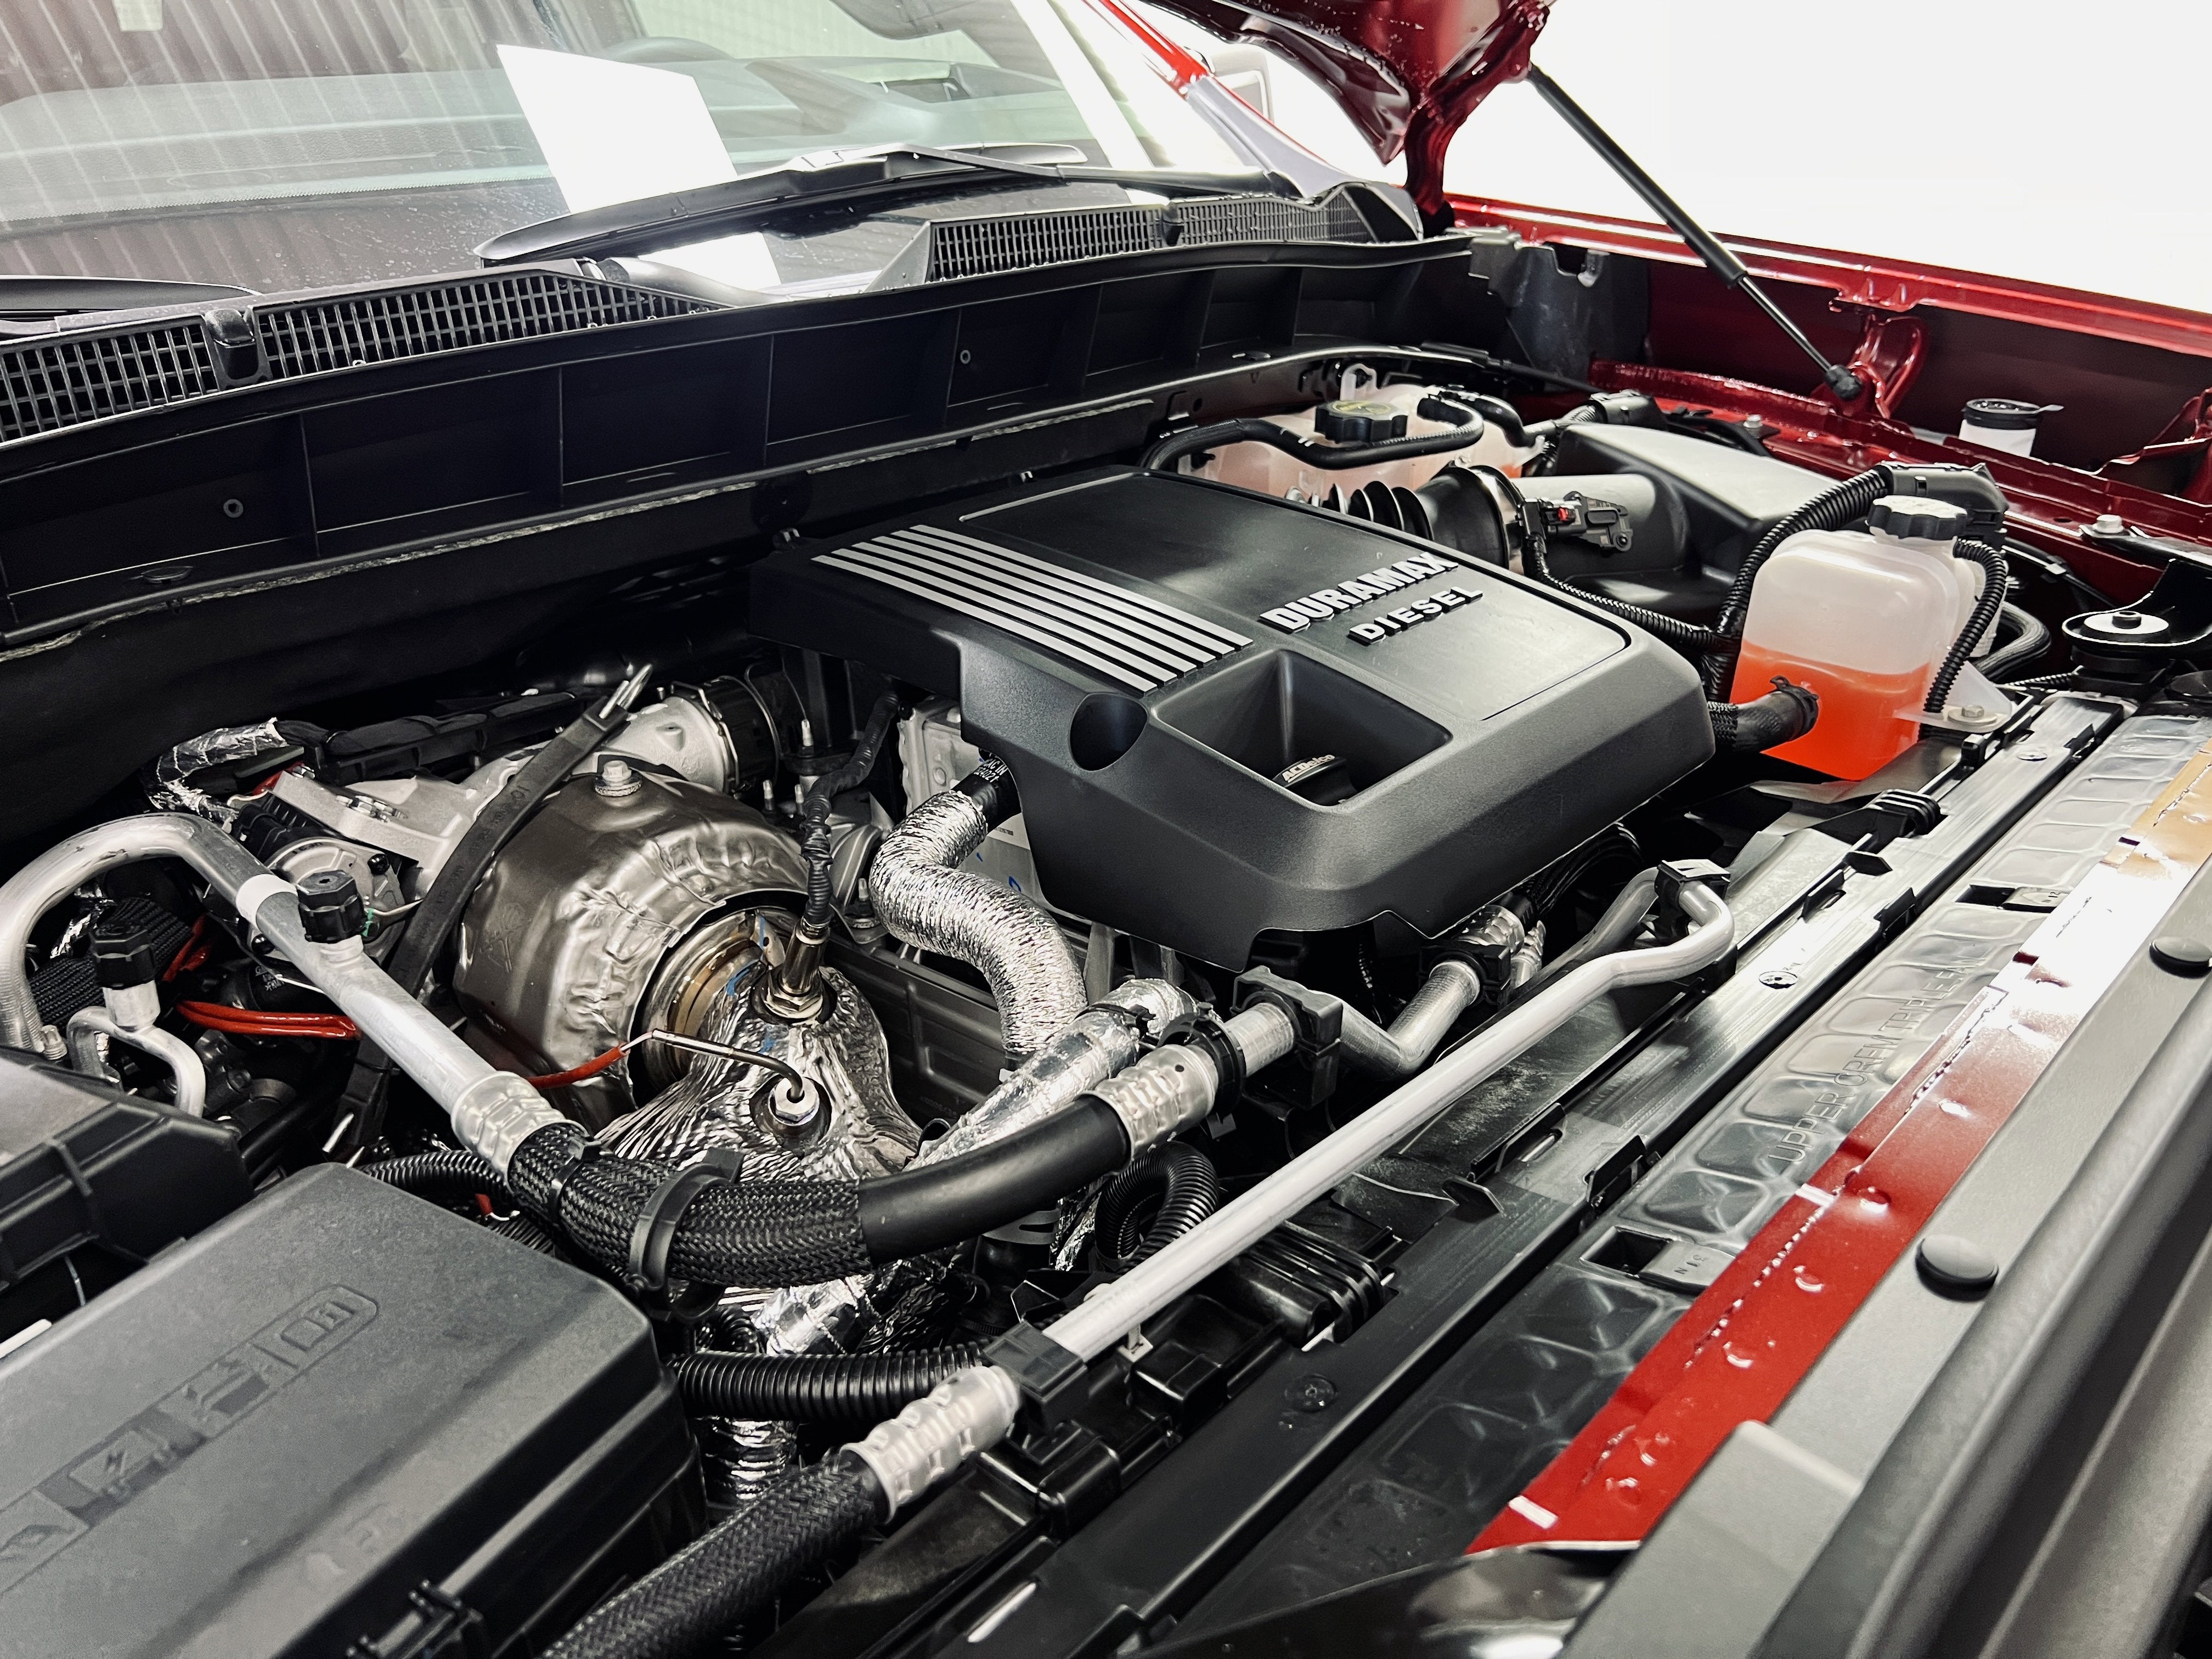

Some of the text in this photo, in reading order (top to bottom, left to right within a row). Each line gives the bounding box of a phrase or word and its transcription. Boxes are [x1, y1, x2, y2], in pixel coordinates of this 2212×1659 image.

[1259, 552, 1459, 633] DURAMAX
[1347, 586, 1483, 645] DIESEL
[1282, 754, 1335, 782] ACDelco
[1768, 1091, 1857, 1163] UPPER
